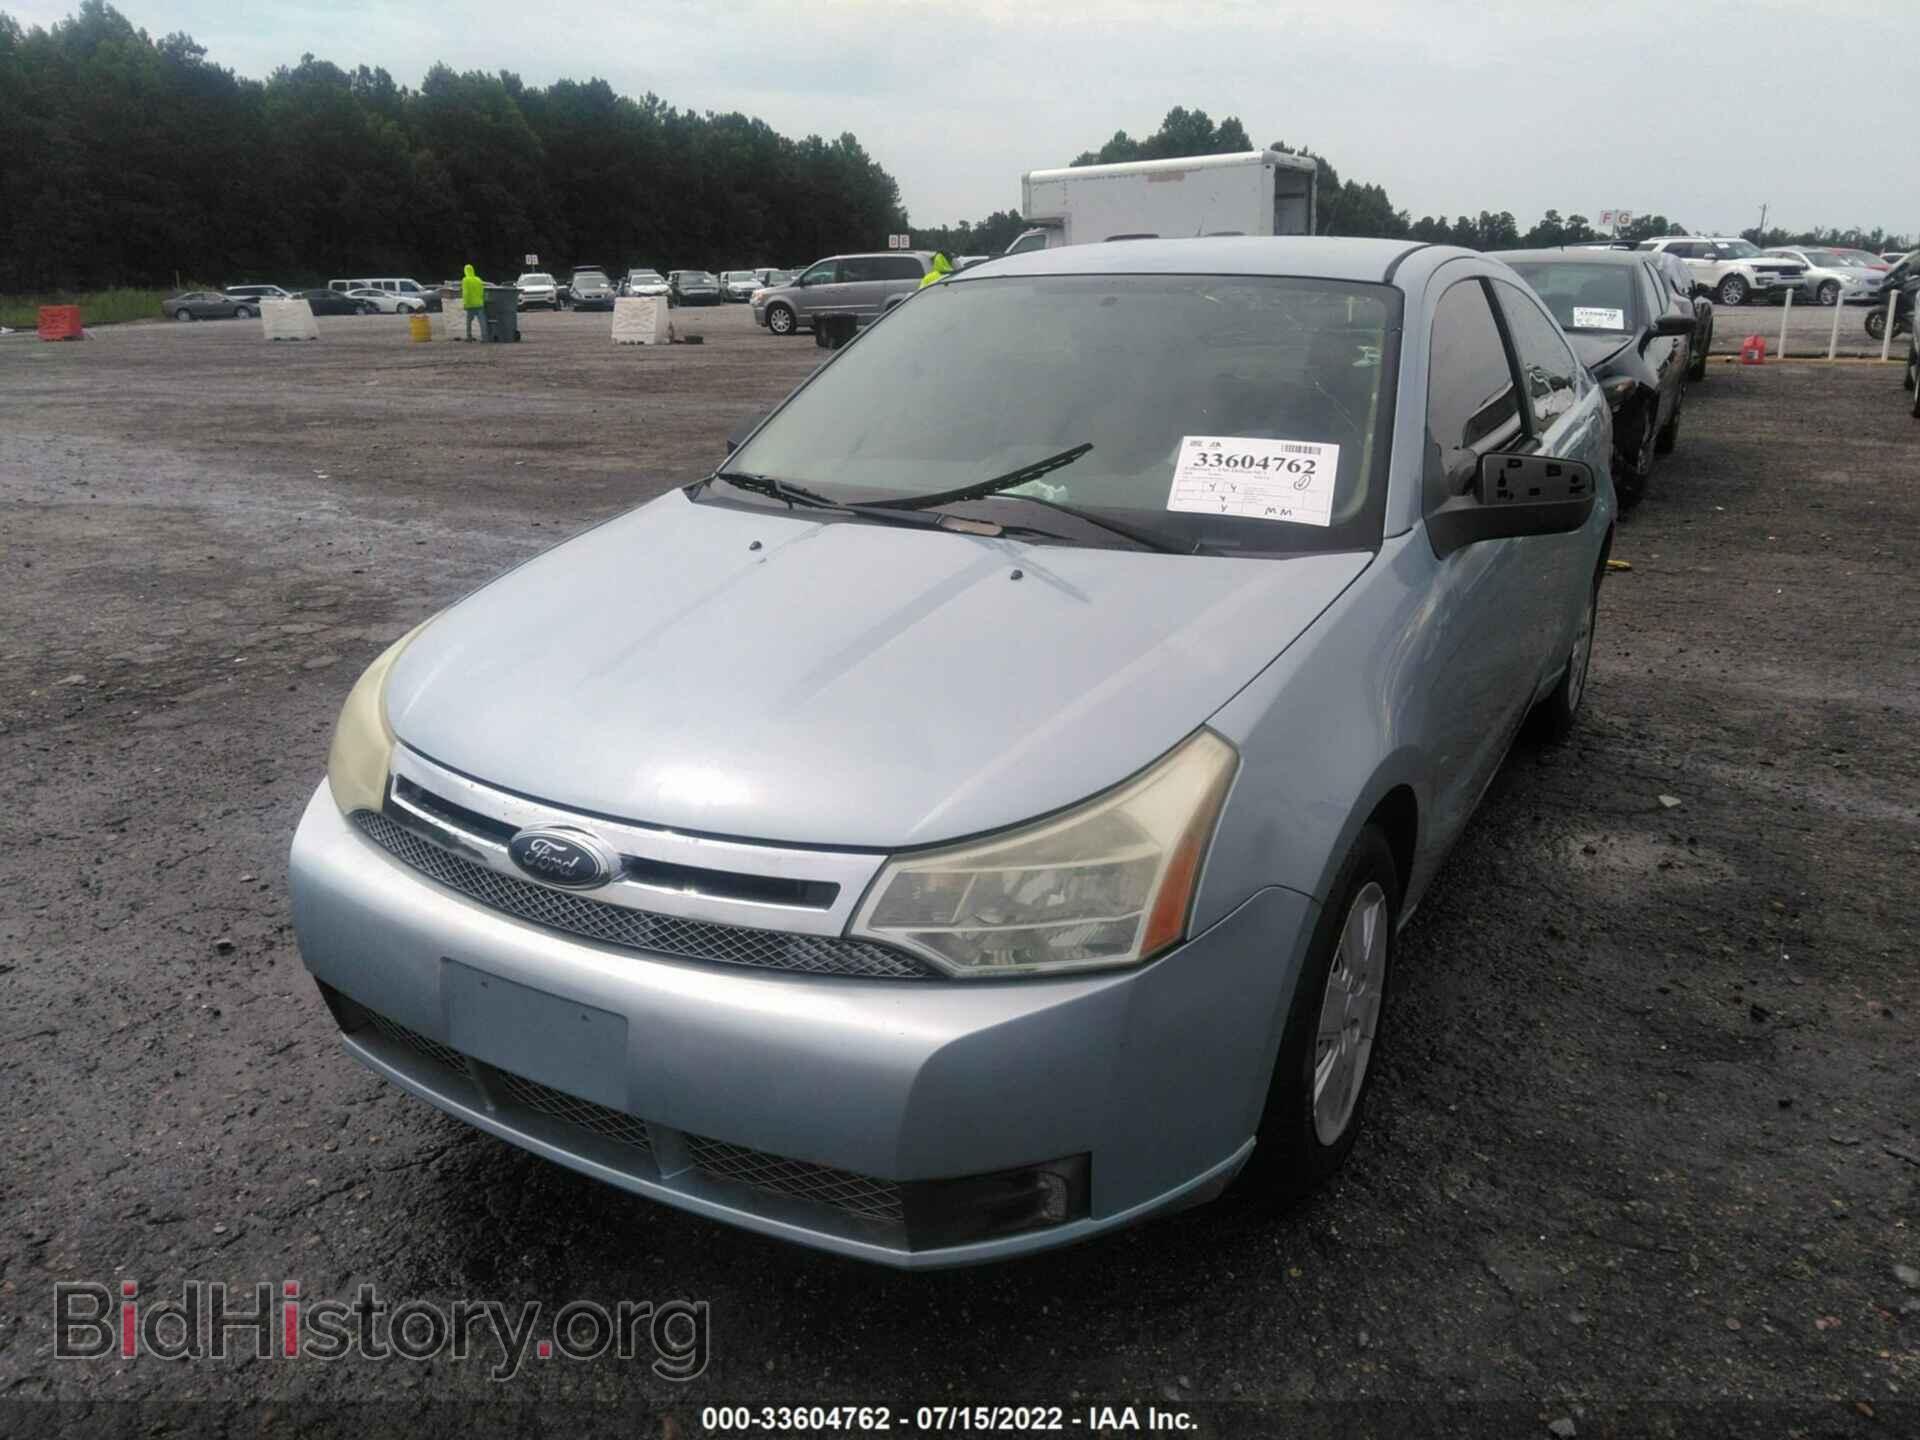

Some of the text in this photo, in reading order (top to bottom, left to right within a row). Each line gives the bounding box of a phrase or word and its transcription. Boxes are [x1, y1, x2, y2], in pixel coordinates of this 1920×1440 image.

[1602, 212, 1629, 224] F G
[1193, 452, 1316, 475] 33604762
[523, 839, 580, 877] Ford
